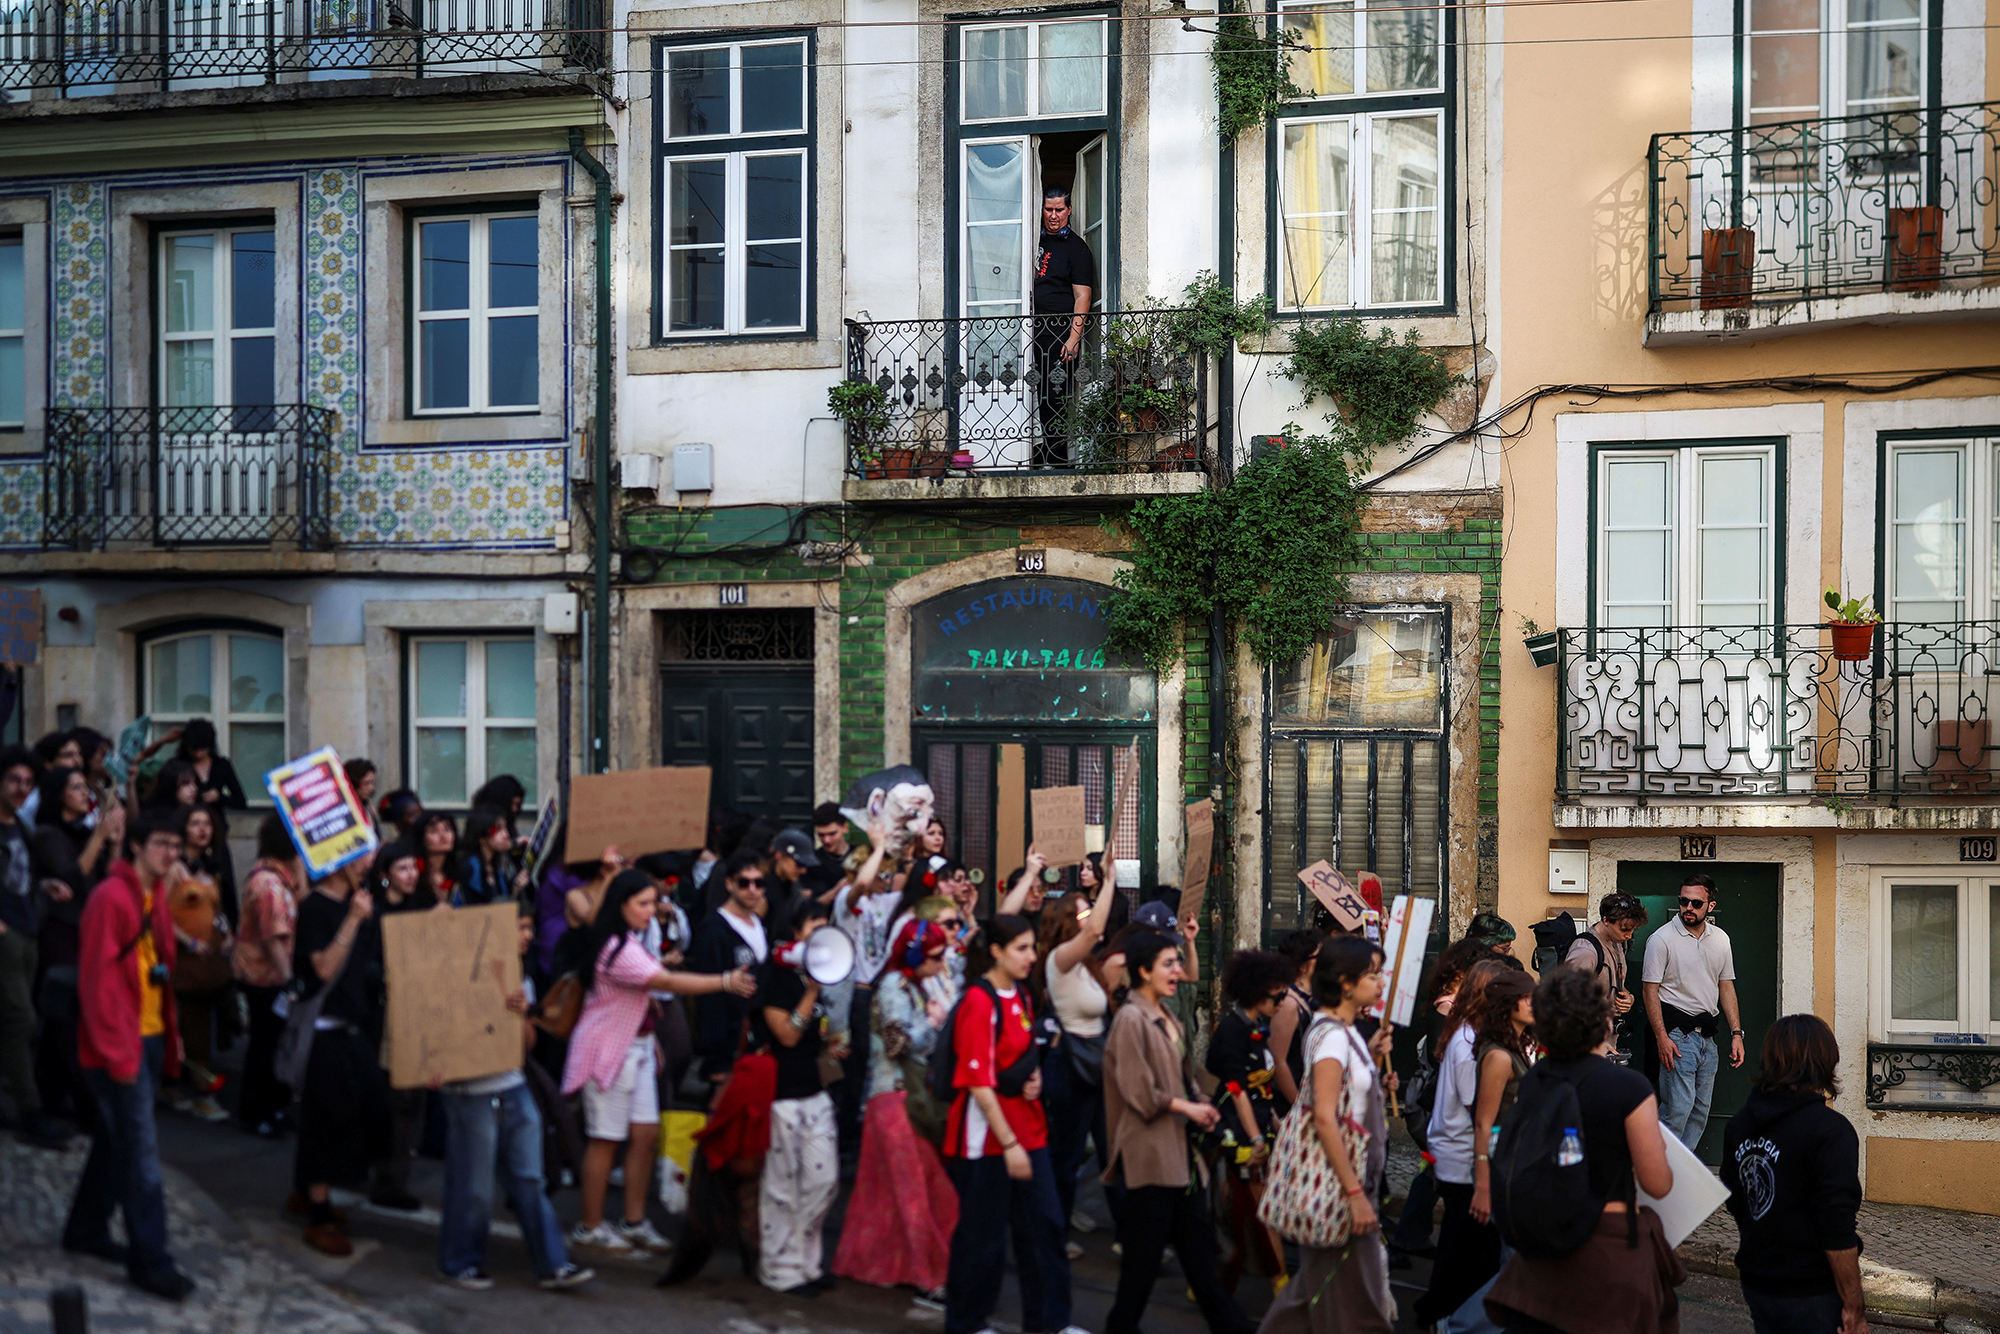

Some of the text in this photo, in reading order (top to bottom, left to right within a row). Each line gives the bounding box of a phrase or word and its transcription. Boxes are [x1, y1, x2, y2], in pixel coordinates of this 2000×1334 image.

[721, 586, 744, 604] 101
[1684, 837, 1712, 857] 107
[1963, 840, 1993, 858] 109
[1735, 1137, 1780, 1163] GEOLOGIA
